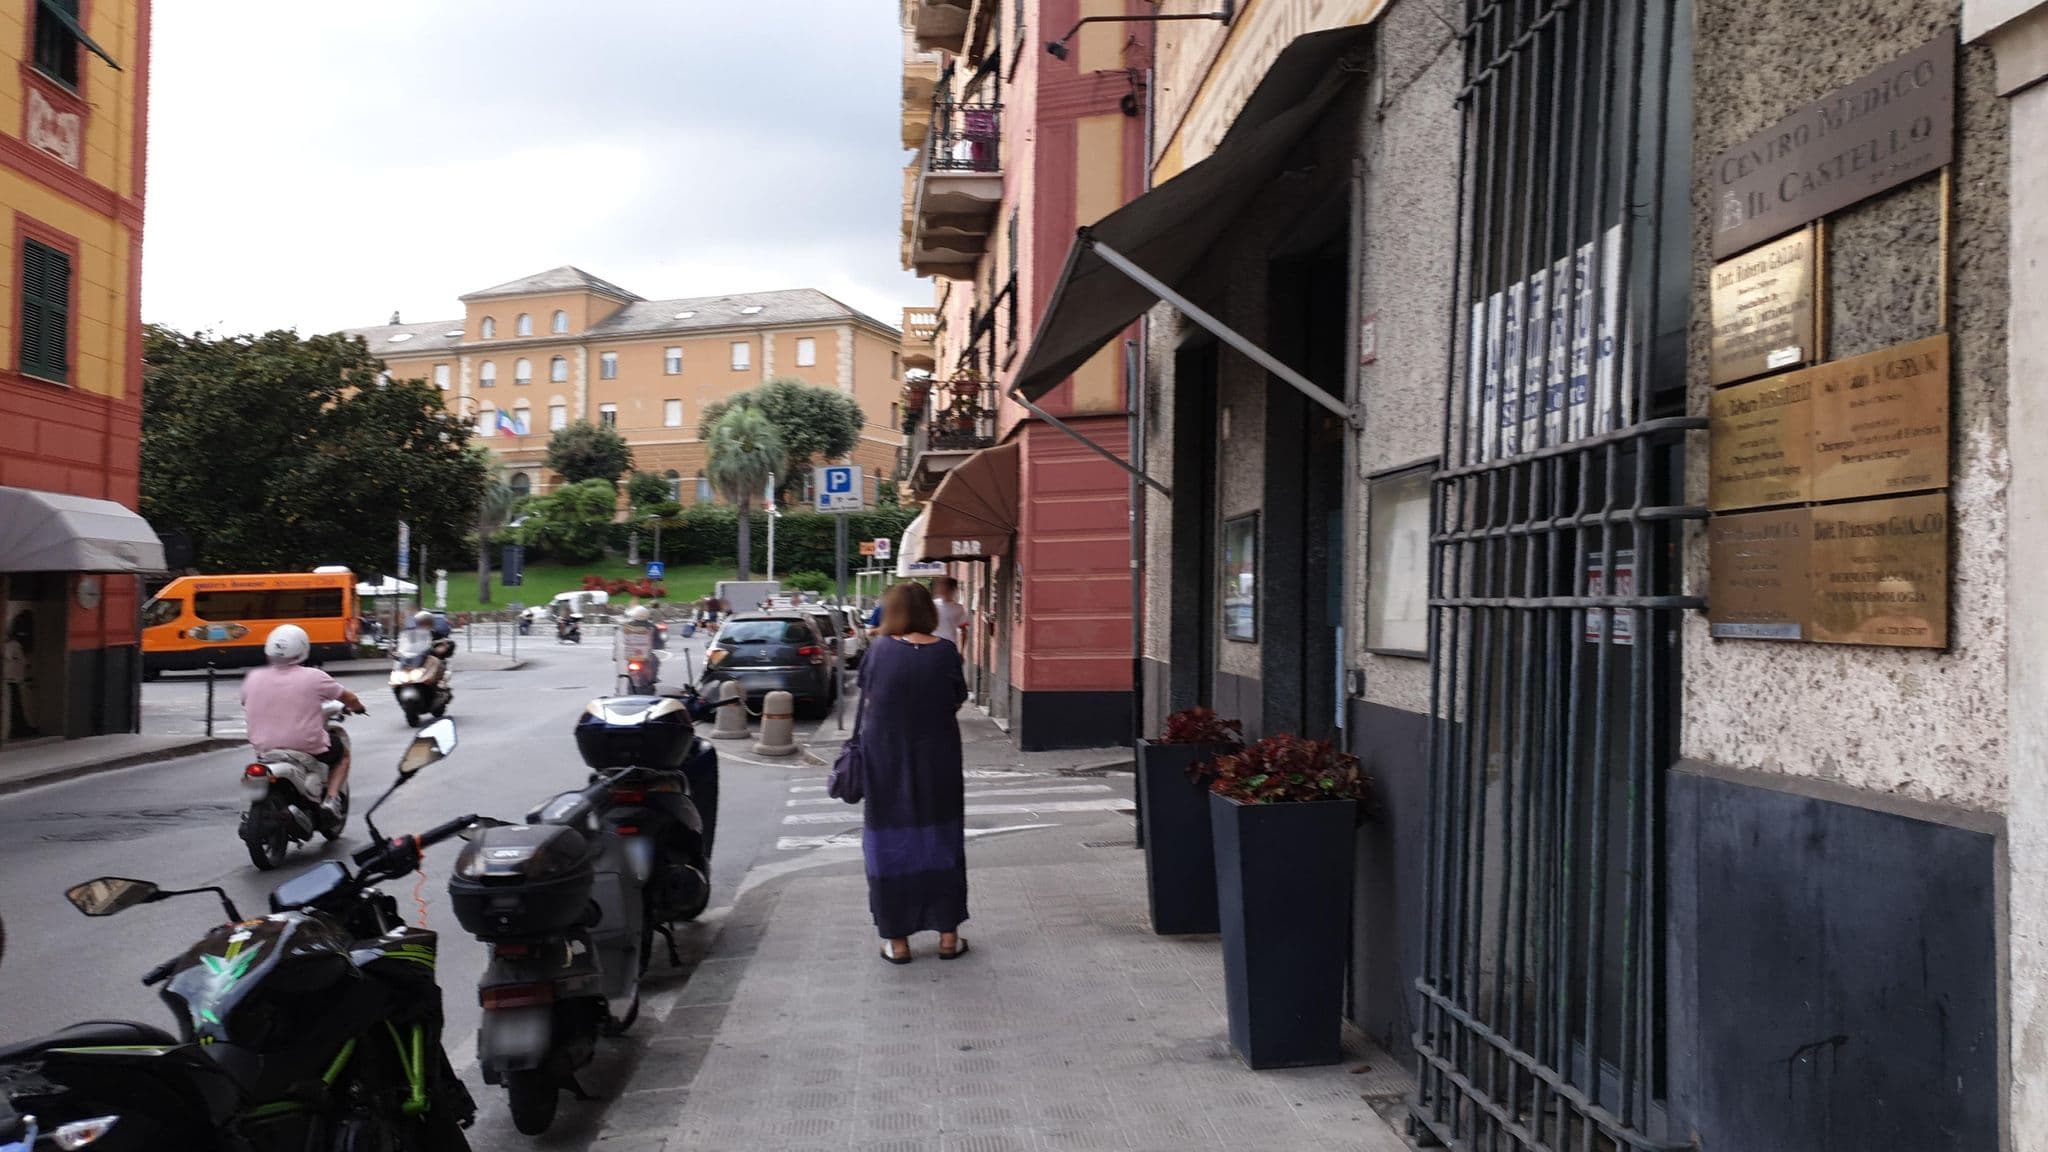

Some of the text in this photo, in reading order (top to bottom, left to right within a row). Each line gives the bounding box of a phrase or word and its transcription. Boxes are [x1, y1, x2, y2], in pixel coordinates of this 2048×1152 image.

[1720, 123, 1810, 185] CENTRO
[1816, 59, 1935, 138] MEDICO
[1777, 114, 1933, 203] CASTELLO
[831, 471, 848, 491] P
[951, 540, 982, 555] BAR
